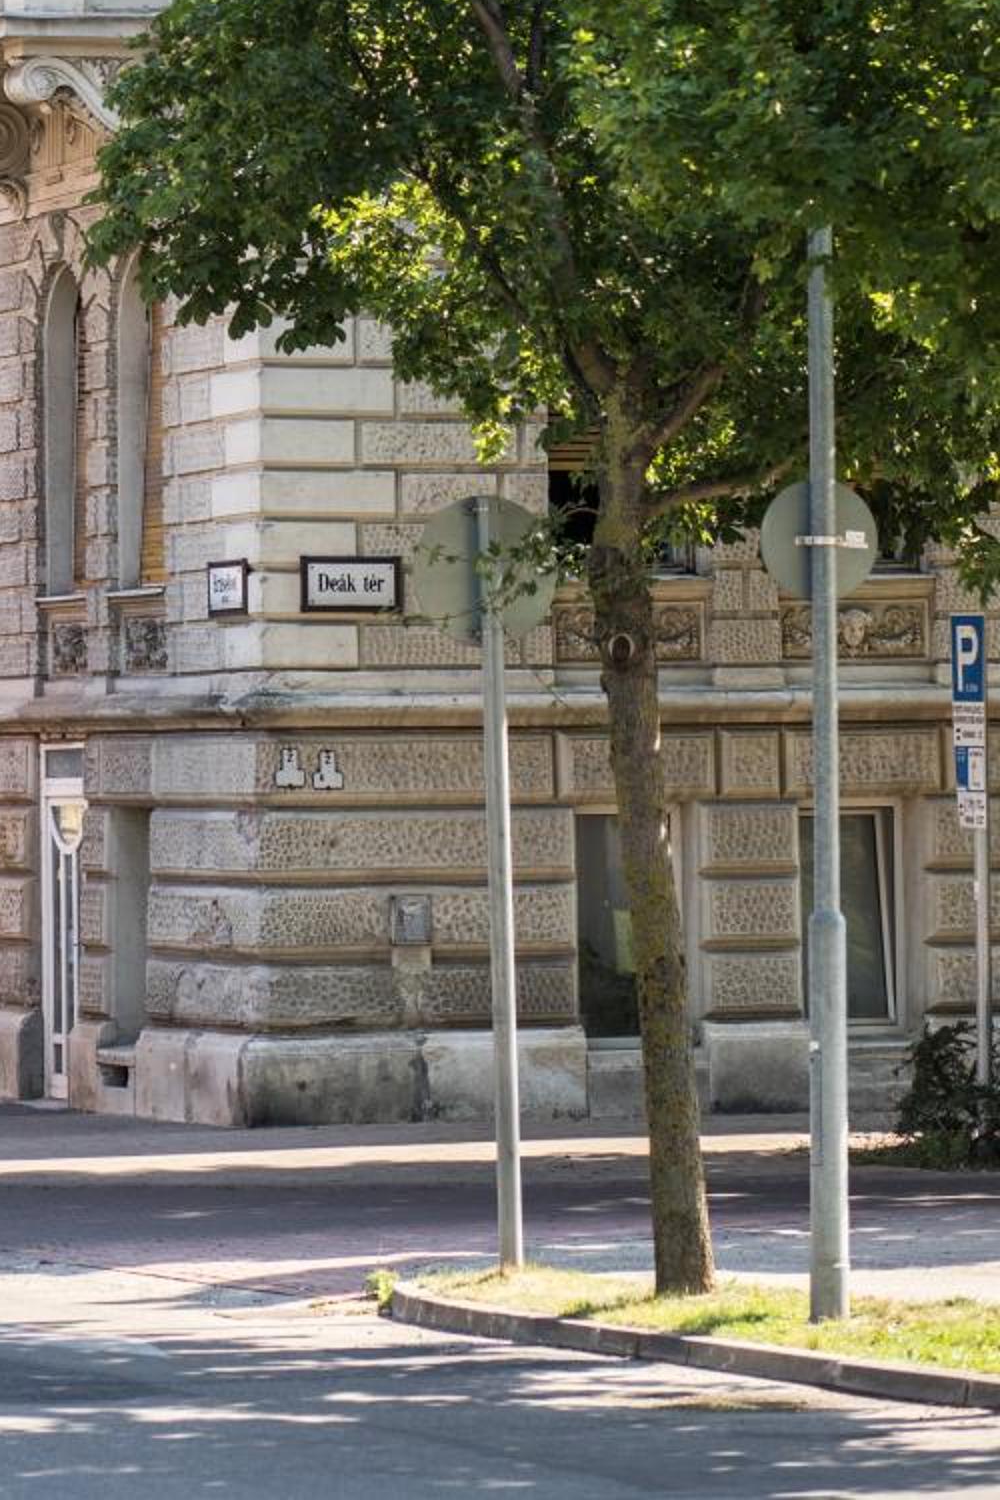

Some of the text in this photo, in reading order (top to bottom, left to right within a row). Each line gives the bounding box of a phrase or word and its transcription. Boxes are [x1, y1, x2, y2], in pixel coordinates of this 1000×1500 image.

[318, 573, 385, 593] Deák tér
[955, 625, 979, 692] P
